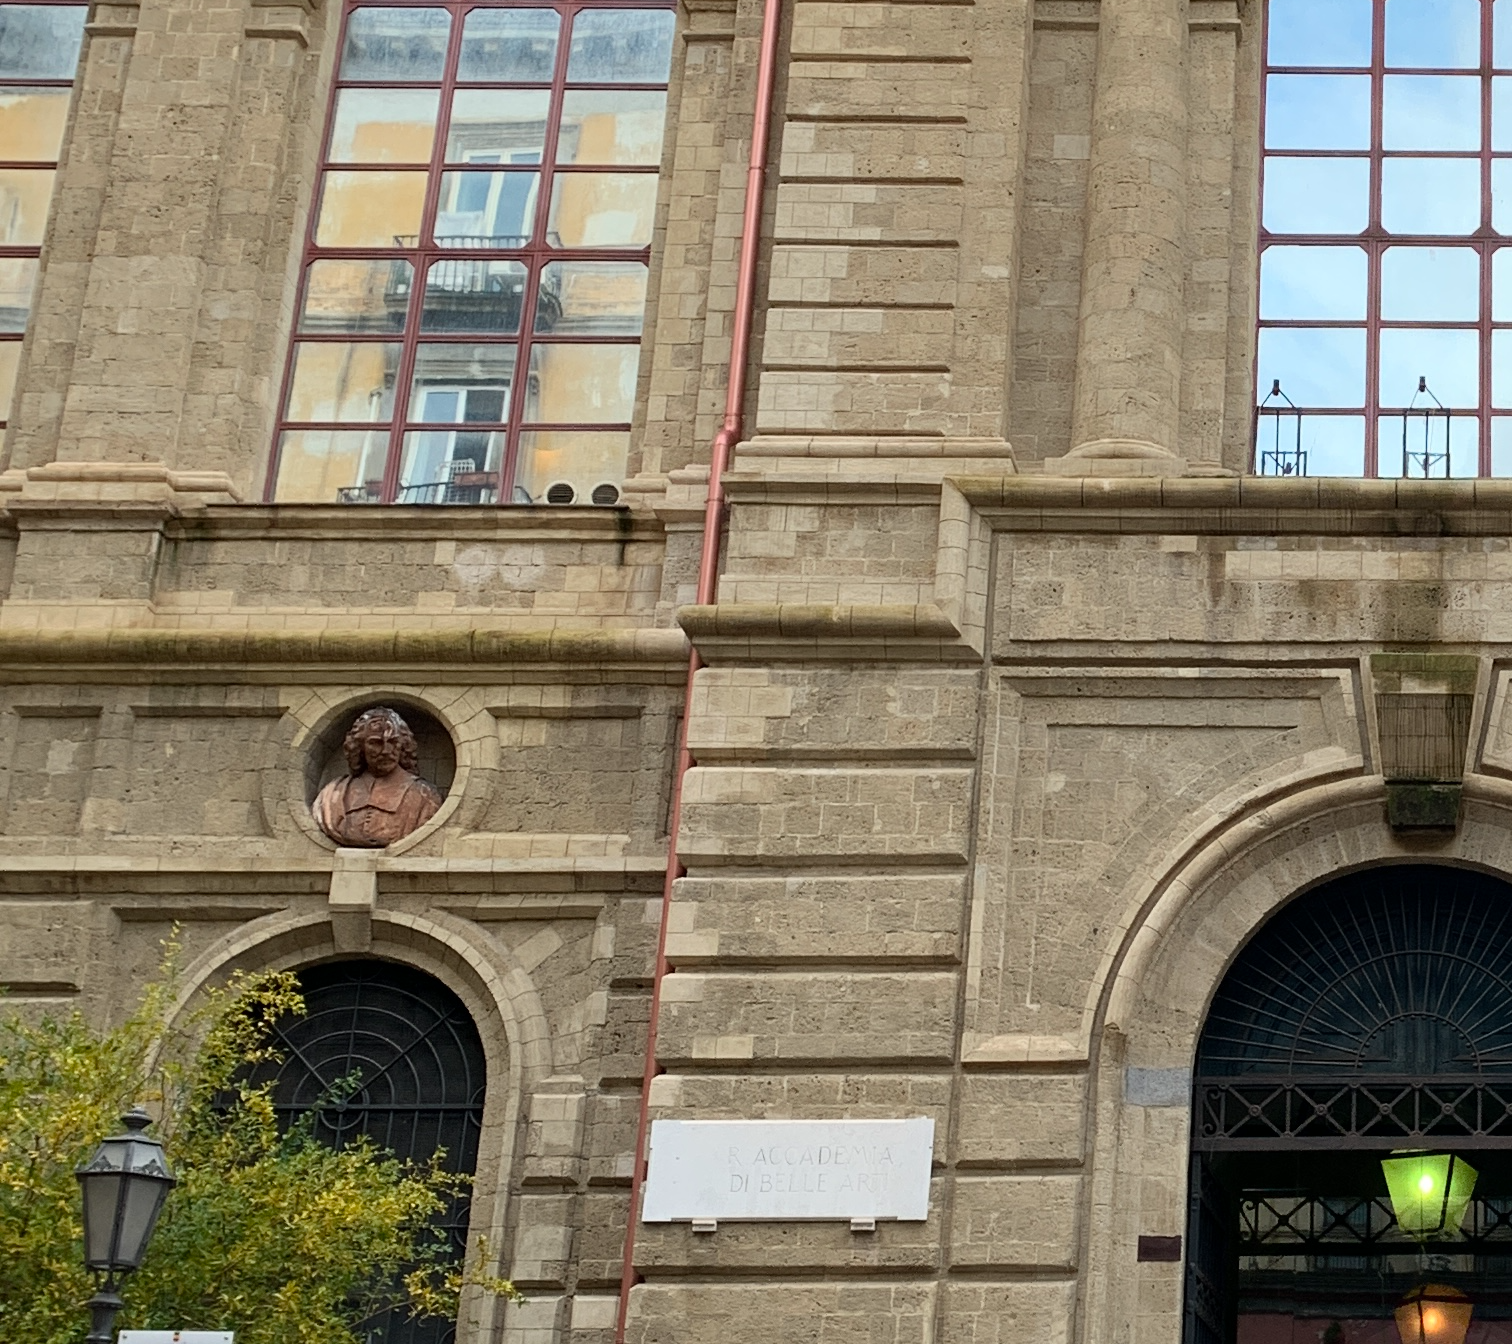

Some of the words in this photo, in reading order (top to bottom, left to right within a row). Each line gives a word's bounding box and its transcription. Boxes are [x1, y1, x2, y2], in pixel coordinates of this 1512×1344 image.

[752, 1146, 894, 1166] ACCADEMIA
[730, 1174, 749, 1193] DI
[760, 1173, 828, 1193] BELLE
[839, 1172, 889, 1193] ARTI
